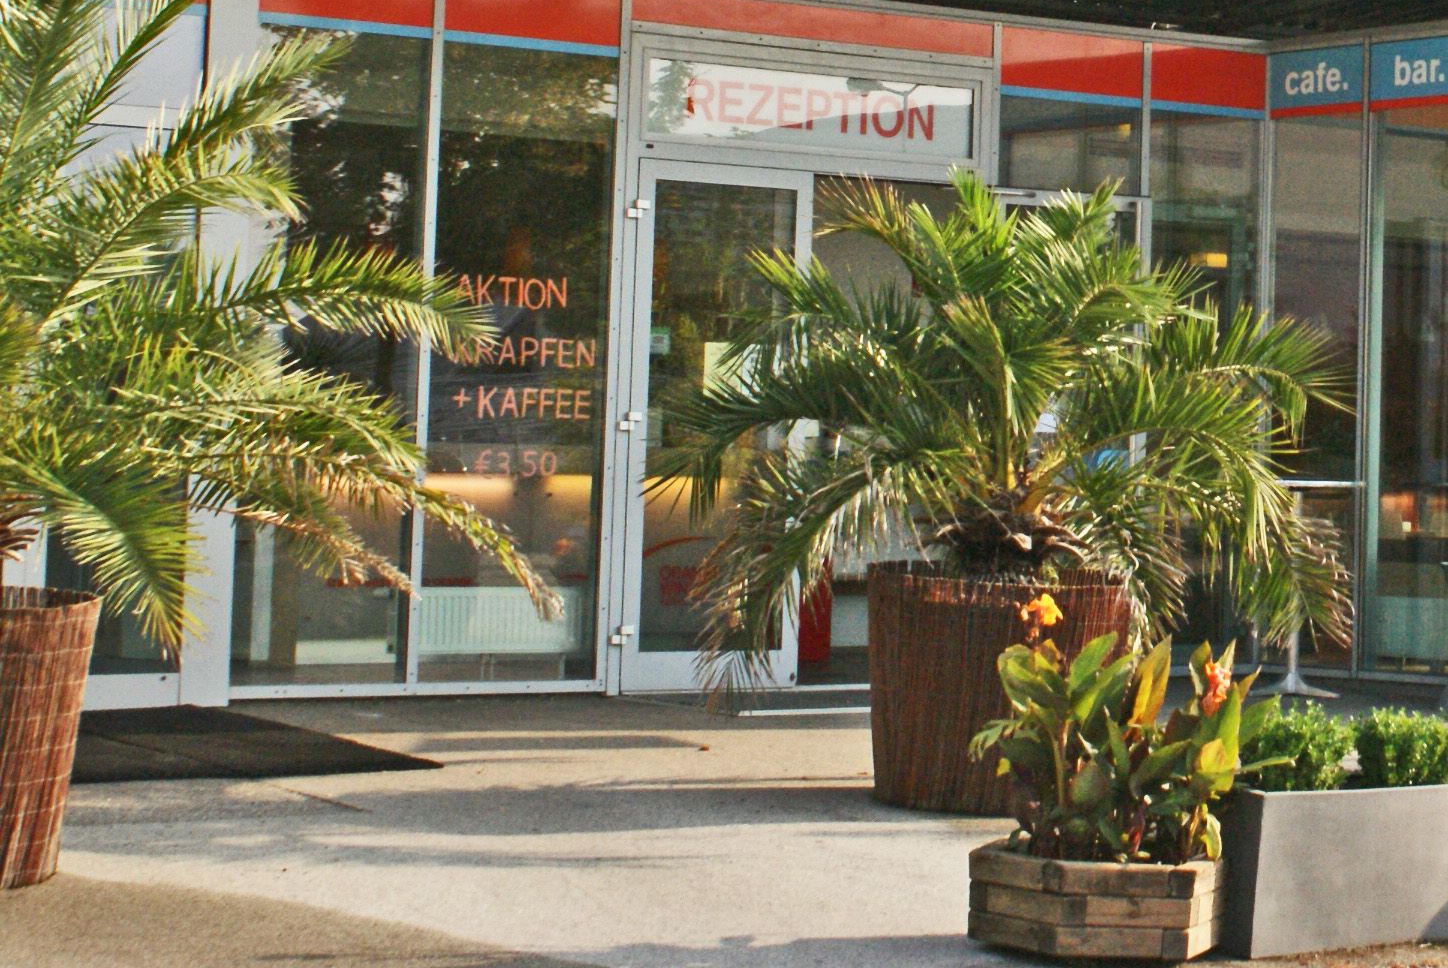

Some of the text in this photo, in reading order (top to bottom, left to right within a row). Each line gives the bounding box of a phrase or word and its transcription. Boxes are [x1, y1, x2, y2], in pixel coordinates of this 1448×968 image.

[1285, 61, 1349, 96] cafe.
[1394, 54, 1446, 87] bar.
[686, 77, 935, 141] REZEPTION
[456, 273, 568, 311] AKTION
[476, 385, 593, 419] KAFFEE
